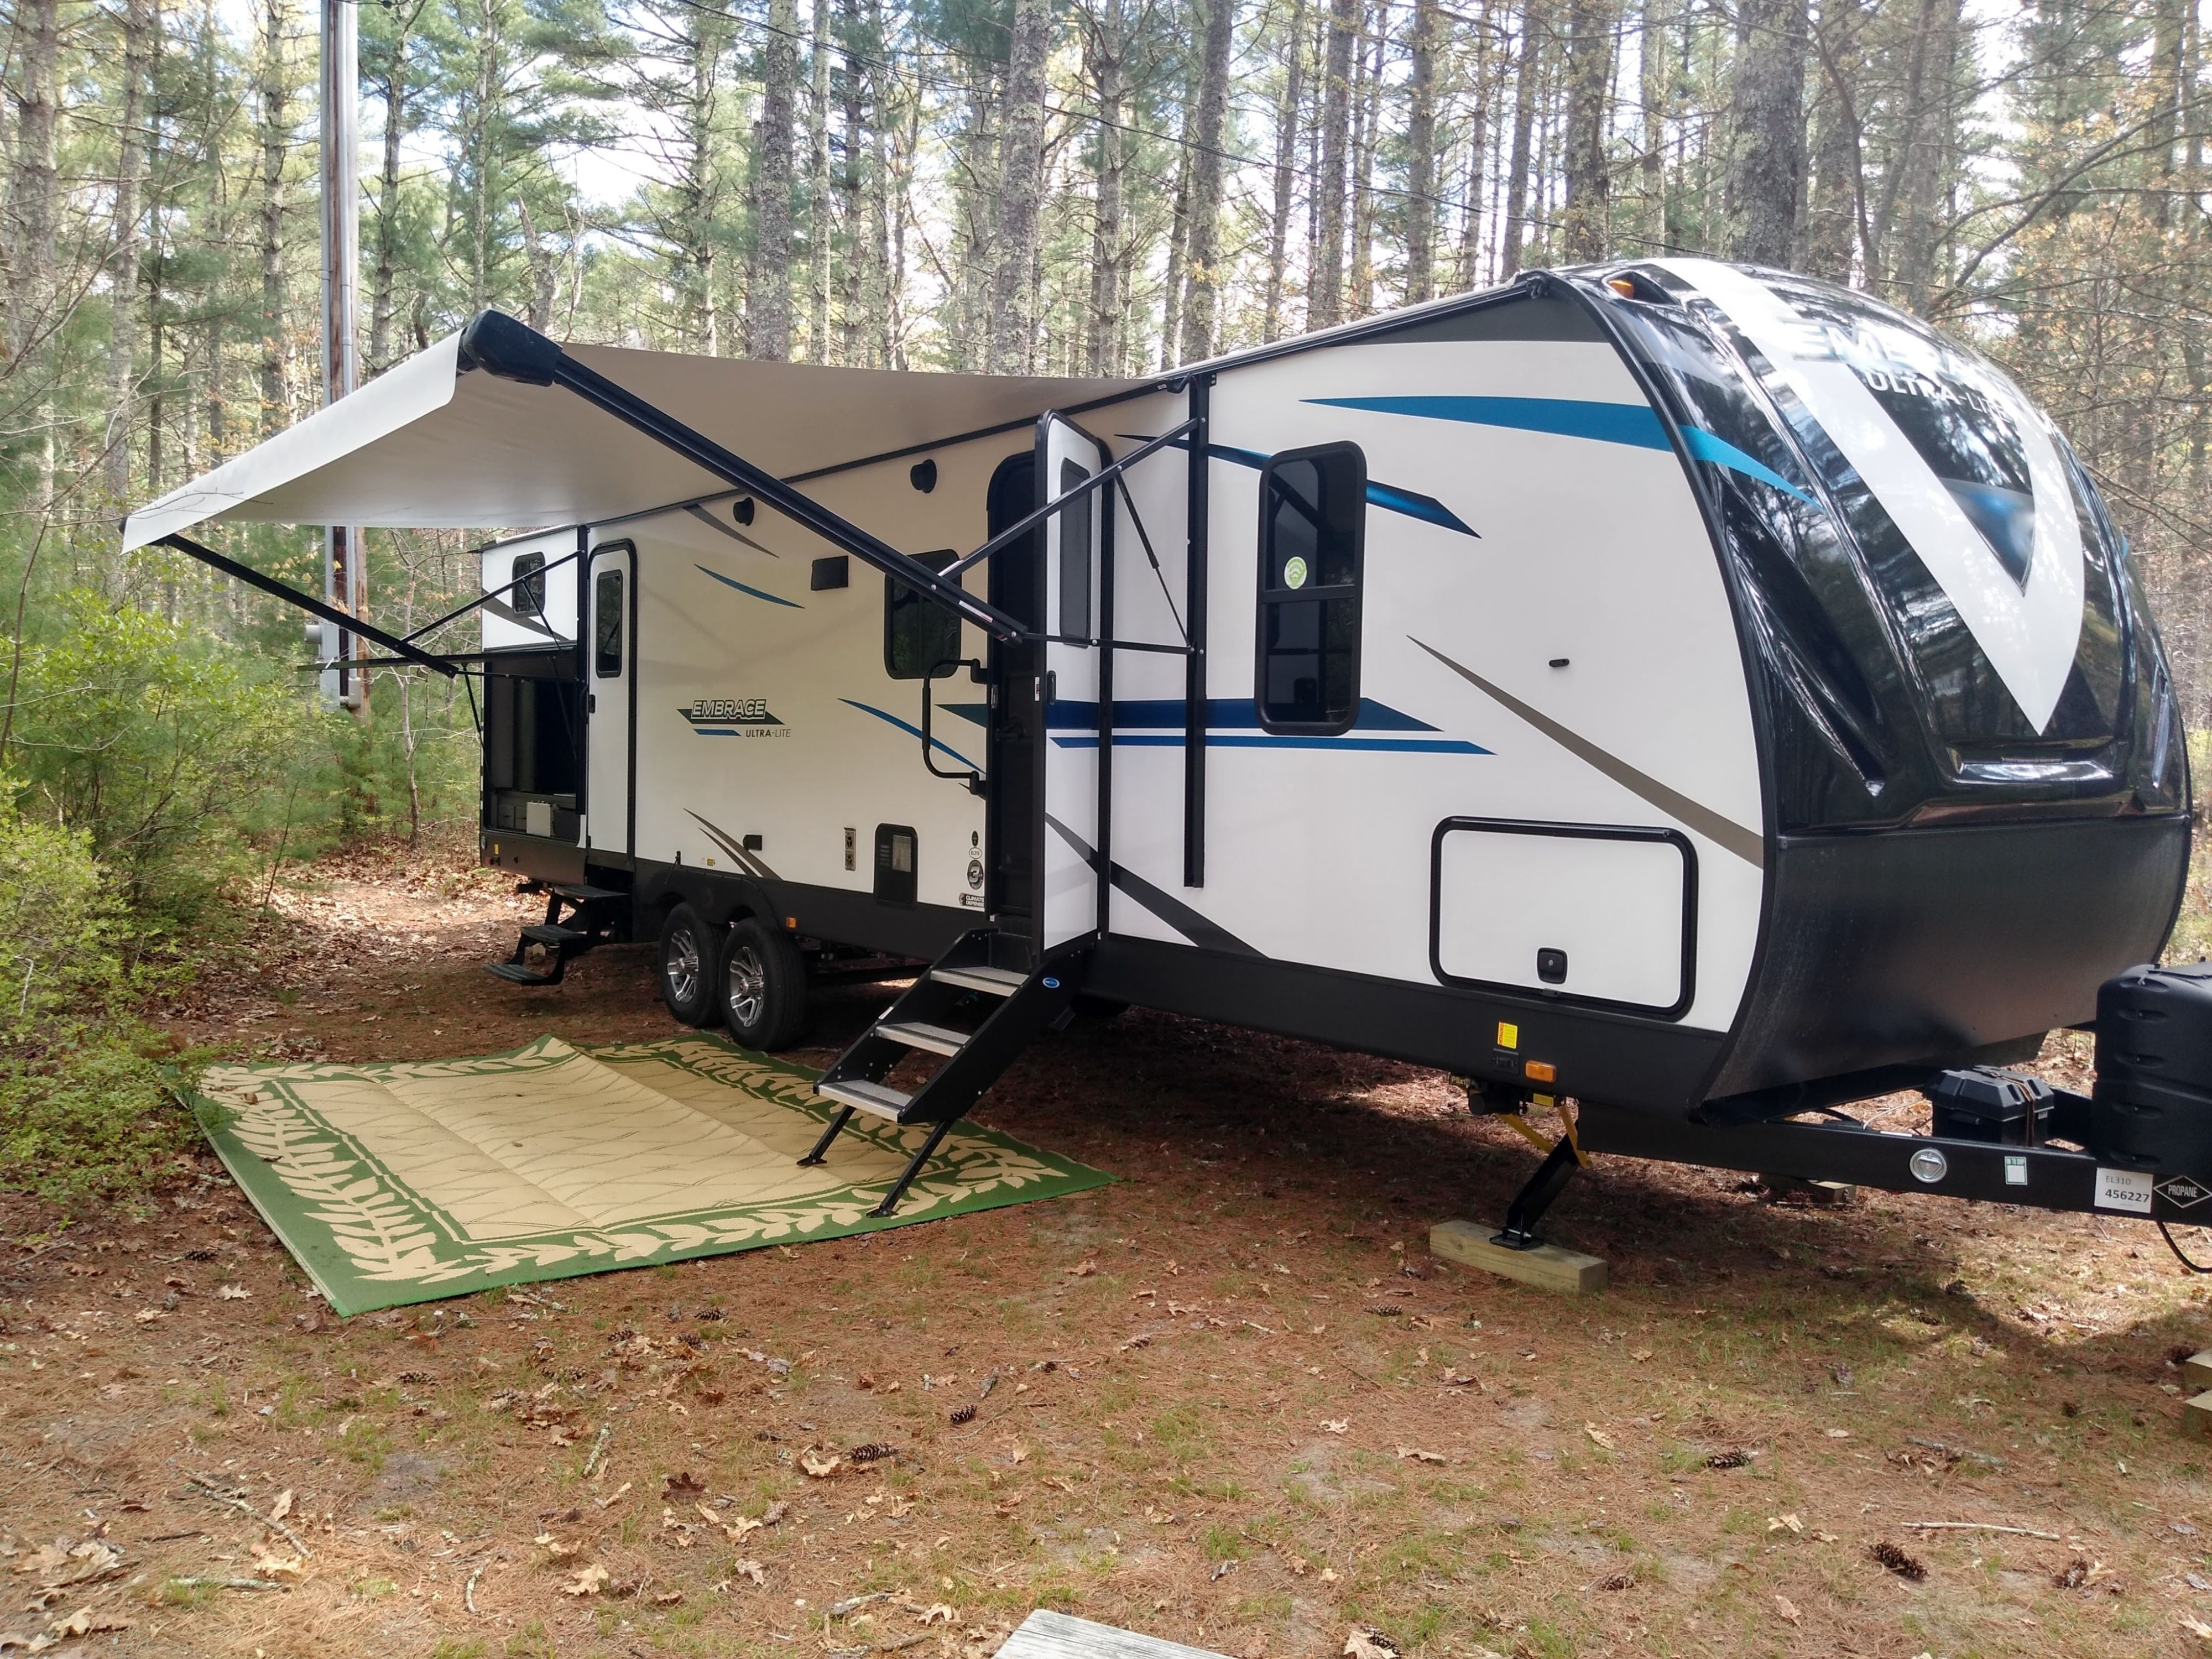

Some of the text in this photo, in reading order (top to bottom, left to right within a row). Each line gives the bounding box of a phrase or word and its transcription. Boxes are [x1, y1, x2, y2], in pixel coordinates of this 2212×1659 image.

[1865, 371, 2011, 423] ULTRA-LITE
[692, 698, 766, 718] EMBRACE
[746, 729, 791, 737] ULTRA-LITE
[2106, 1176, 2131, 1185] EL310
[2105, 1189, 2150, 1203] 456227
[2168, 1185, 2197, 1198] PROPANE
